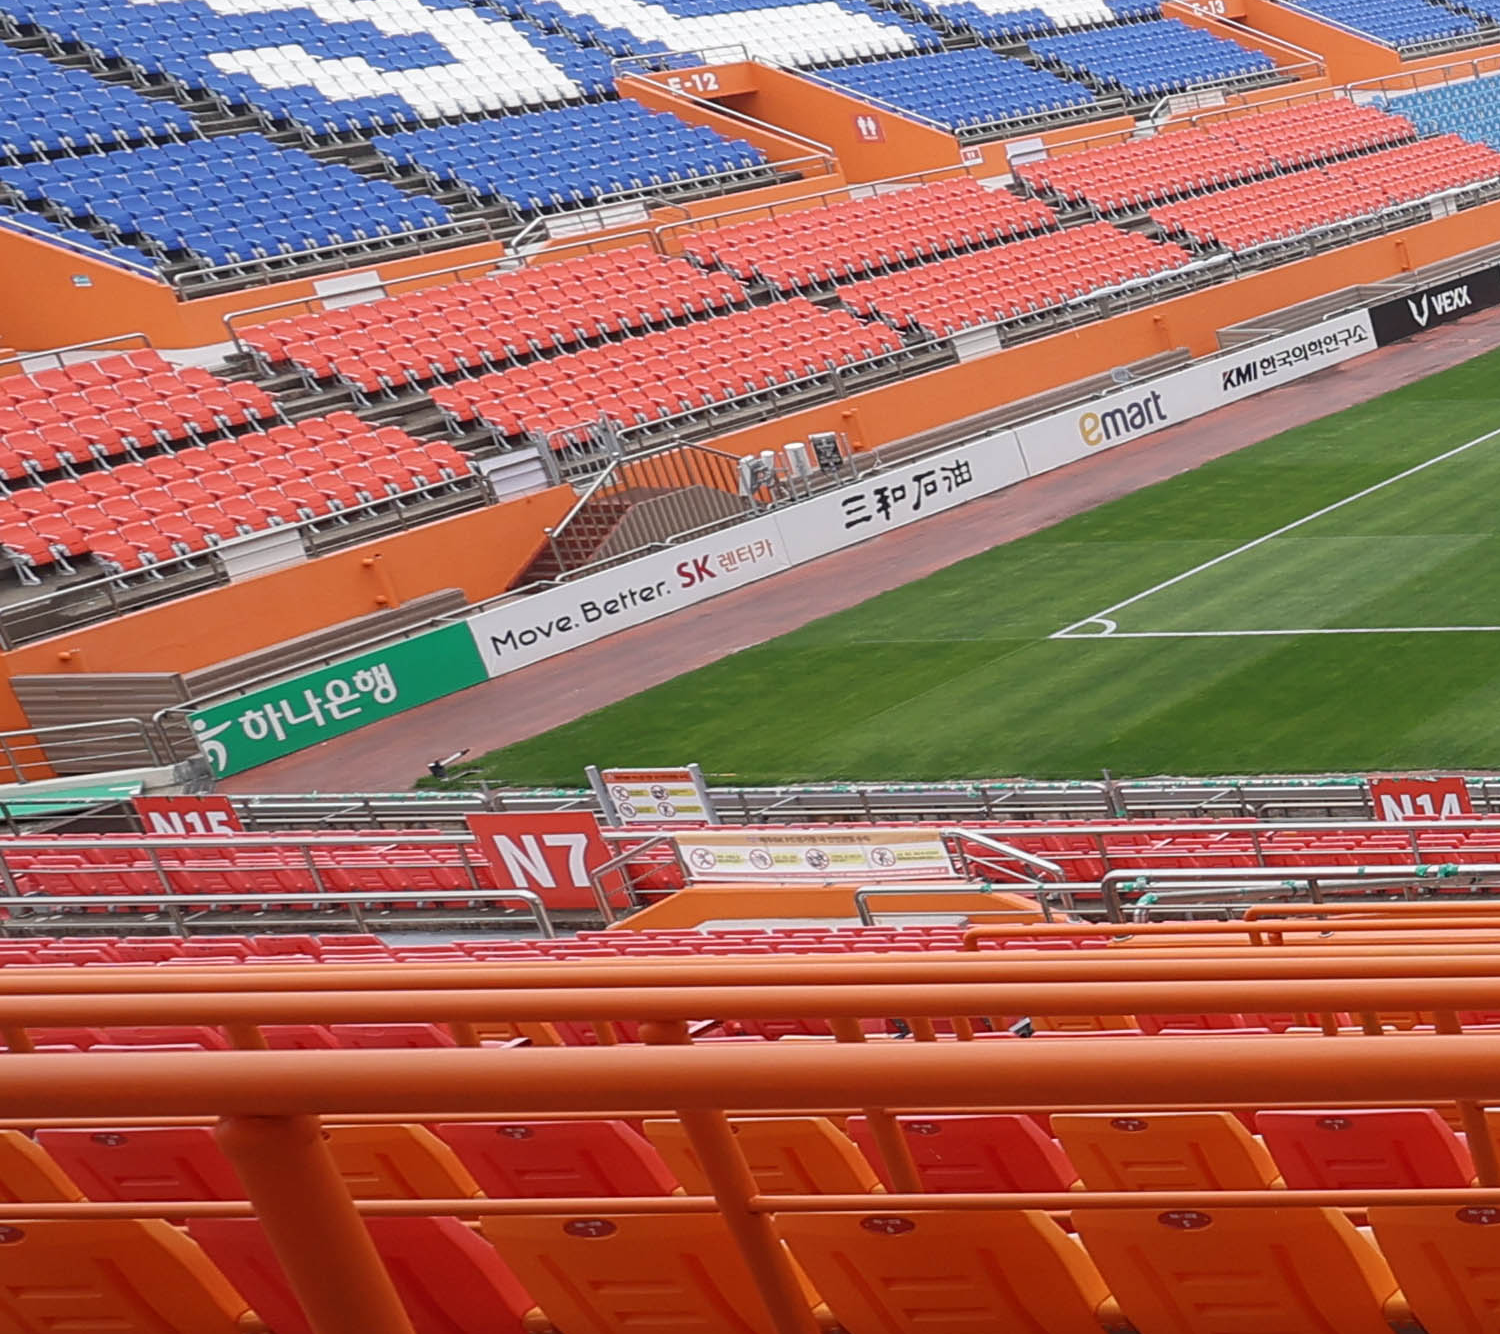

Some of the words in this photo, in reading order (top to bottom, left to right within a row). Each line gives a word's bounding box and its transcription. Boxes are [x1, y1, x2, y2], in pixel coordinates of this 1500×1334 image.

[668, 73, 719, 97] E-12
[1430, 284, 1472, 316] VEXX
[1222, 359, 1259, 393] KMI
[1259, 323, 1369, 378] 한국의학연구소
[1078, 389, 1168, 447] emart
[841, 459, 973, 531] 三和石油
[490, 618, 581, 657] Move.
[581, 578, 672, 626] Better.
[676, 555, 717, 590] SK
[717, 538, 776, 577] 렌터카
[238, 663, 398, 744] 하나은행
[492, 833, 592, 888] N7
